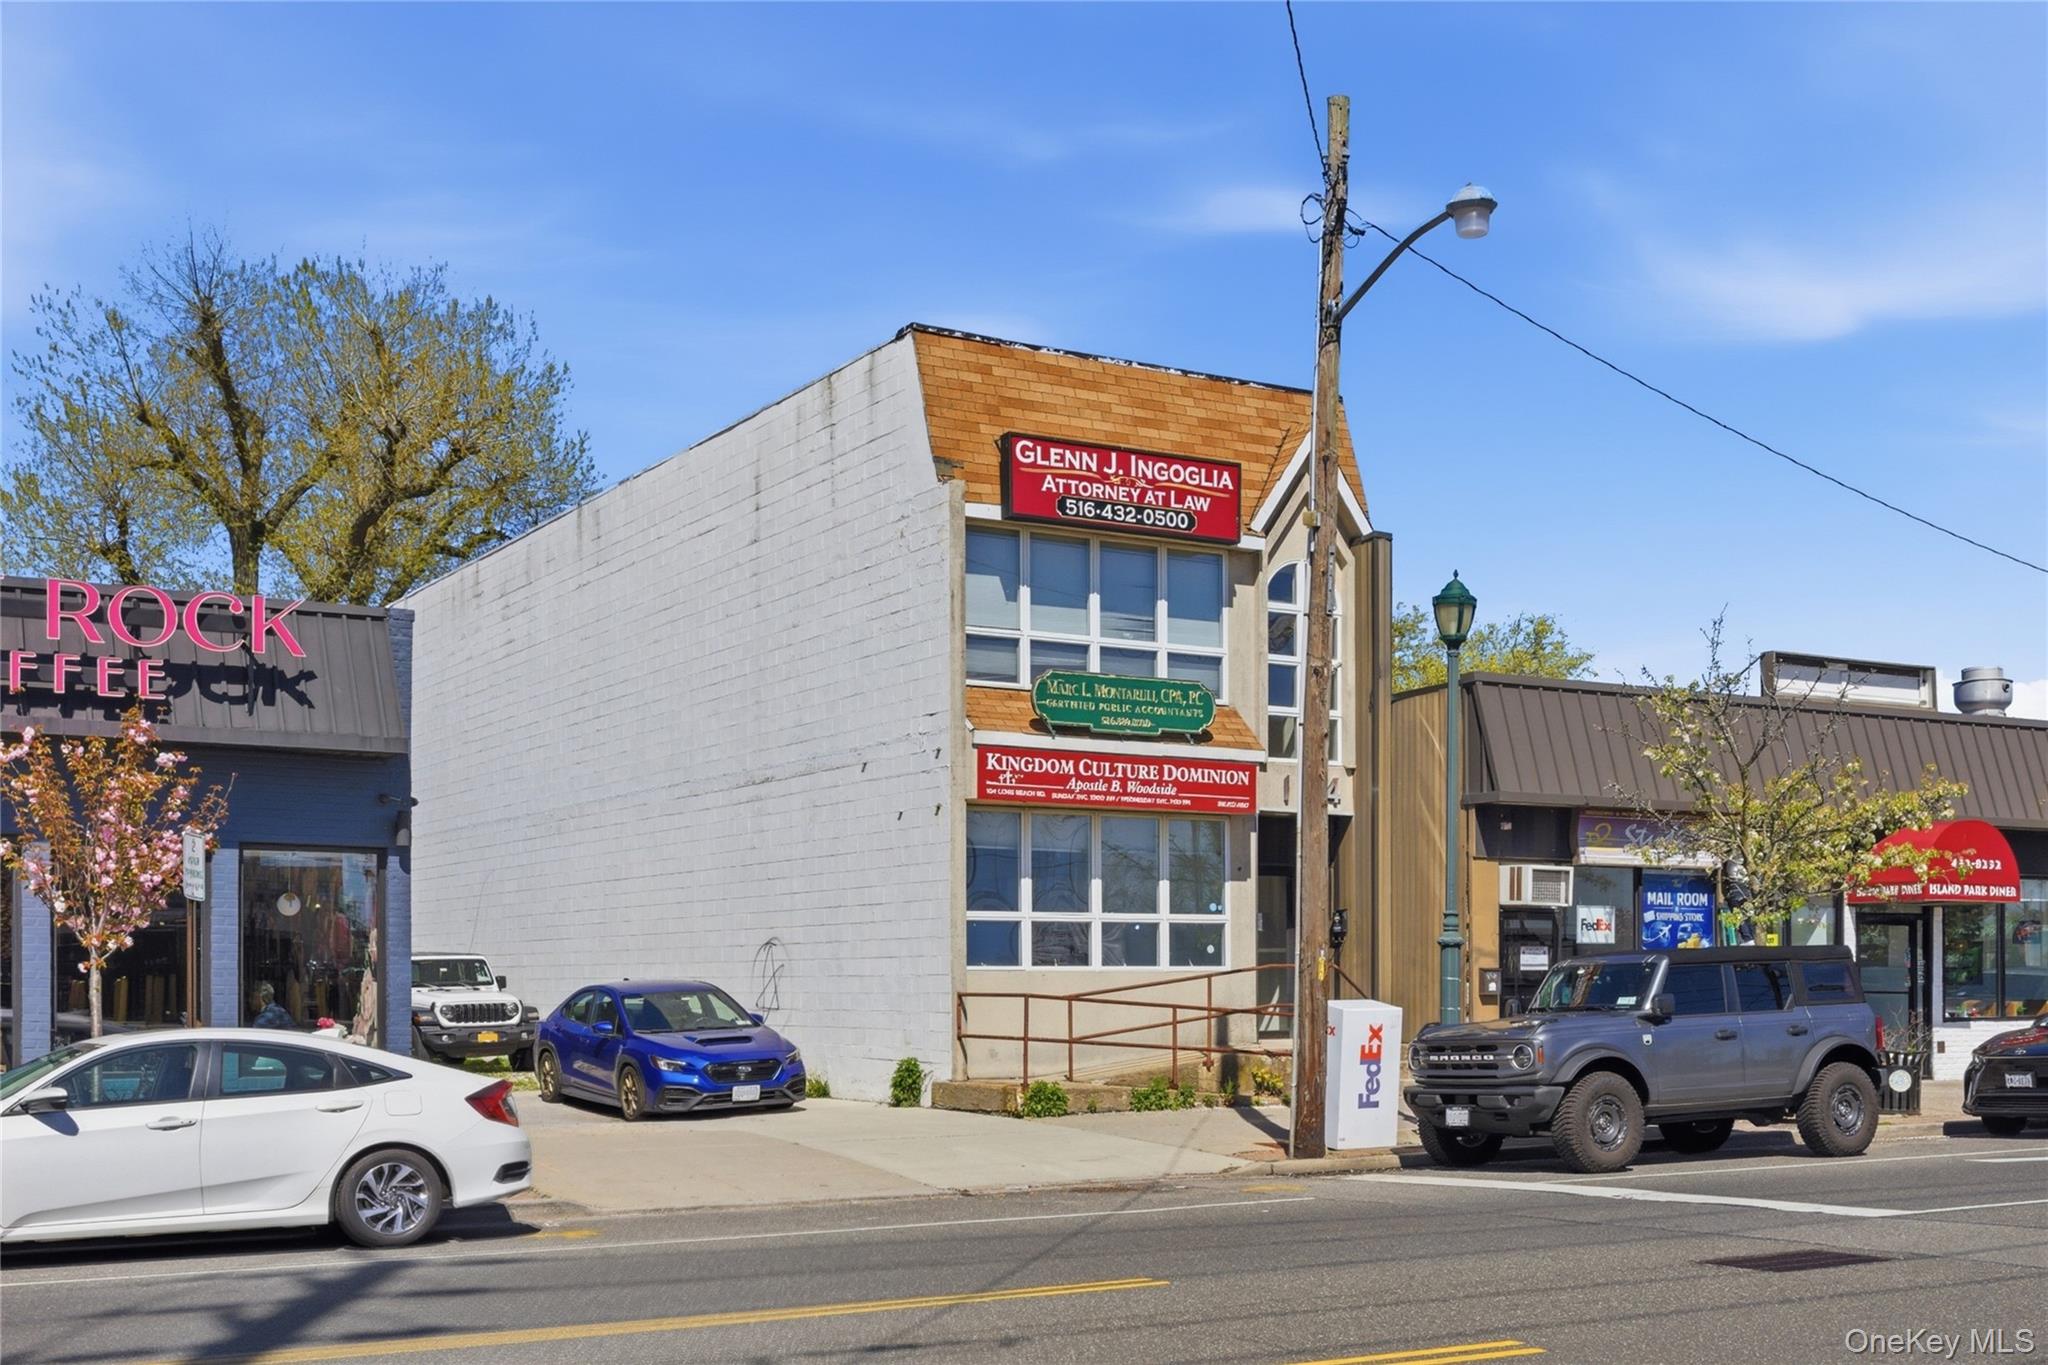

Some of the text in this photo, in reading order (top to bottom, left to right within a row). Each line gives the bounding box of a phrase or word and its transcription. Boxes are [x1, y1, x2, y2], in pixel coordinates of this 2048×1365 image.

[1015, 440, 1235, 491] GLENN J. INGOGLIA
[1041, 475, 1212, 512] ATTORNEY AT LAW
[45, 578, 307, 658] ROCK
[1047, 680, 1080, 697] MARC
[1189, 690, 1205, 706] PC
[1098, 702, 1132, 713] PUBLIC
[986, 752, 1250, 786] KINGDOM CULTURE DOMINION
[1066, 776, 1177, 796] Apostle B. Woodside
[1647, 891, 1708, 907] MAIL ROOM
[1929, 883, 2017, 898] ISLAND PARK DINER
[1357, 1023, 1384, 1110] FedEx
